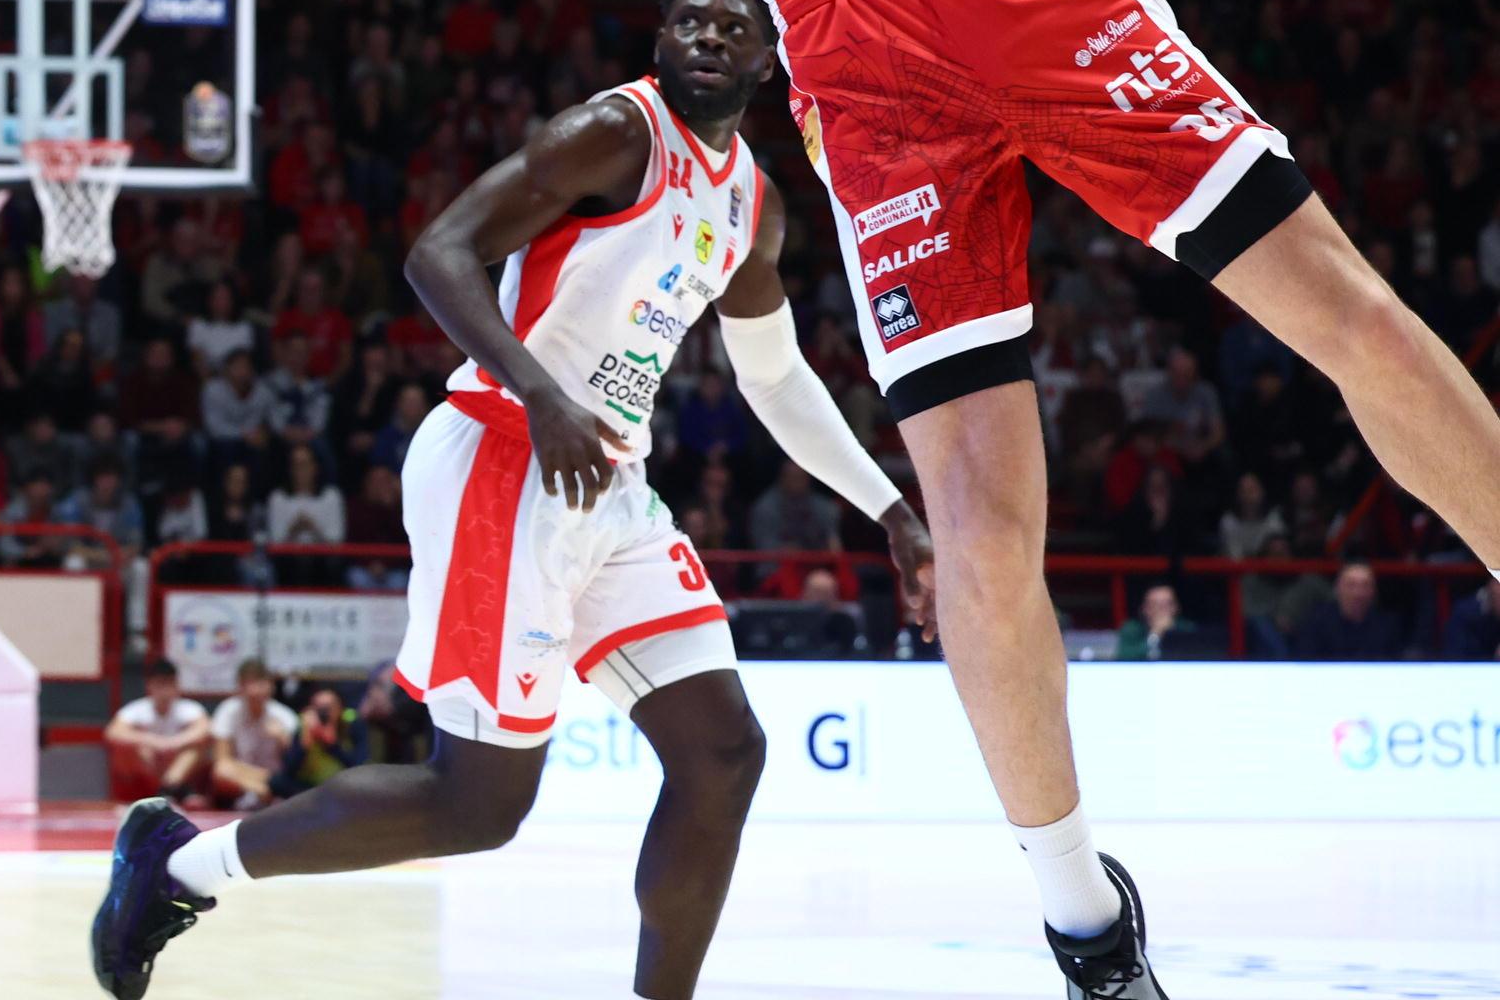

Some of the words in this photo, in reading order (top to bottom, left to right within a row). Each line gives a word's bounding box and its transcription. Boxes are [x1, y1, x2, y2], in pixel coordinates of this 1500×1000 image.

[1086, 31, 1112, 57] Stile
[1104, 10, 1142, 41] Ricamo
[1104, 38, 1191, 113] nts
[1148, 71, 1204, 113] INFORMATICA
[866, 197, 911, 221] FARMACIE
[868, 206, 913, 231] COMUNALI
[864, 231, 950, 284] SALICE
